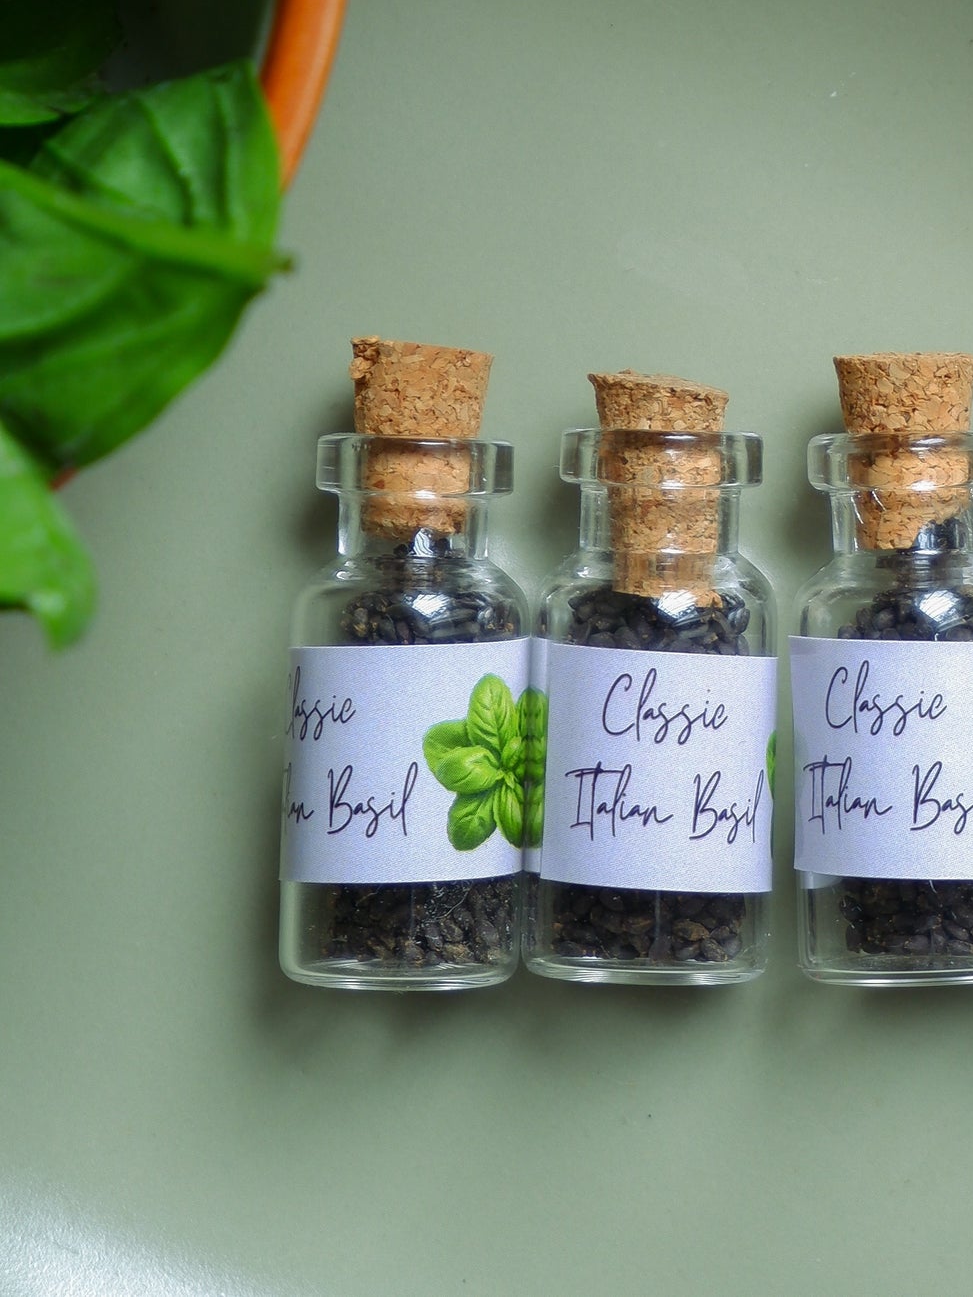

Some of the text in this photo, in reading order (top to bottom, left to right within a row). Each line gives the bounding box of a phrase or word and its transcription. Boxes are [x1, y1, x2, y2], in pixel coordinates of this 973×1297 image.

[286, 666, 356, 741] lassic
[602, 667, 729, 745] Classic
[825, 659, 948, 736] Classic
[327, 761, 418, 839] Basil
[565, 761, 764, 844] Italian Basil
[803, 754, 892, 834] Italian
